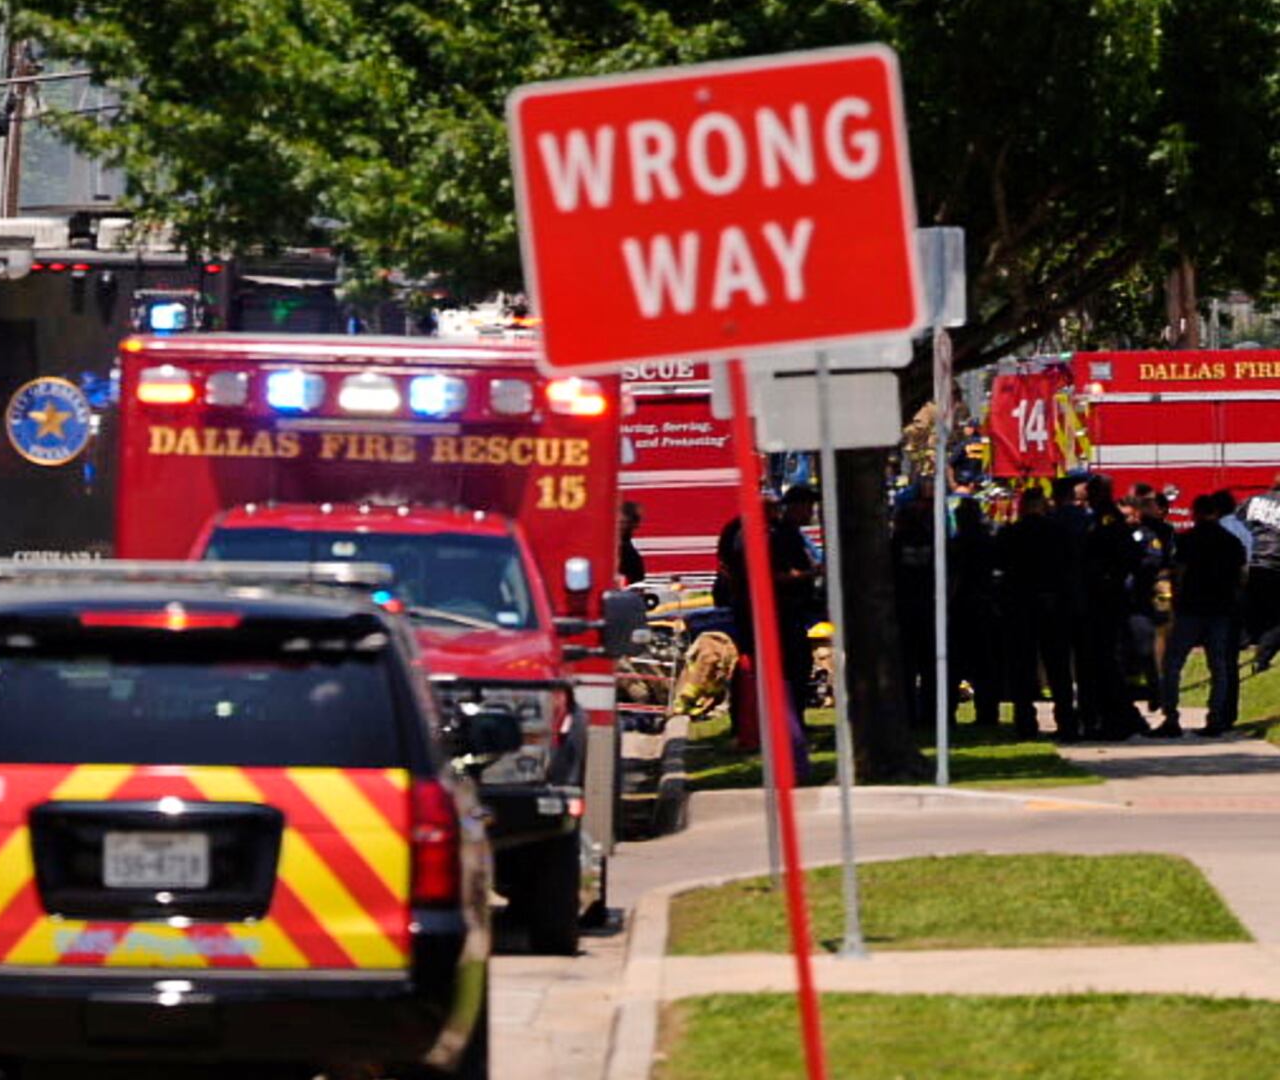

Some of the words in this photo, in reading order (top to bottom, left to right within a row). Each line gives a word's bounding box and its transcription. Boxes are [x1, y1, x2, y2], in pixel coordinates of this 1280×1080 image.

[538, 96, 881, 213] WRONG
[621, 218, 814, 318] WAY
[622, 359, 694, 380] SCUE
[1139, 363, 1226, 380] DALLAS
[148, 426, 300, 459] DALLAS
[319, 433, 415, 463] FIRE
[431, 436, 590, 467] RESCUE
[1011, 399, 1048, 453] 14
[535, 475, 587, 510] 15
